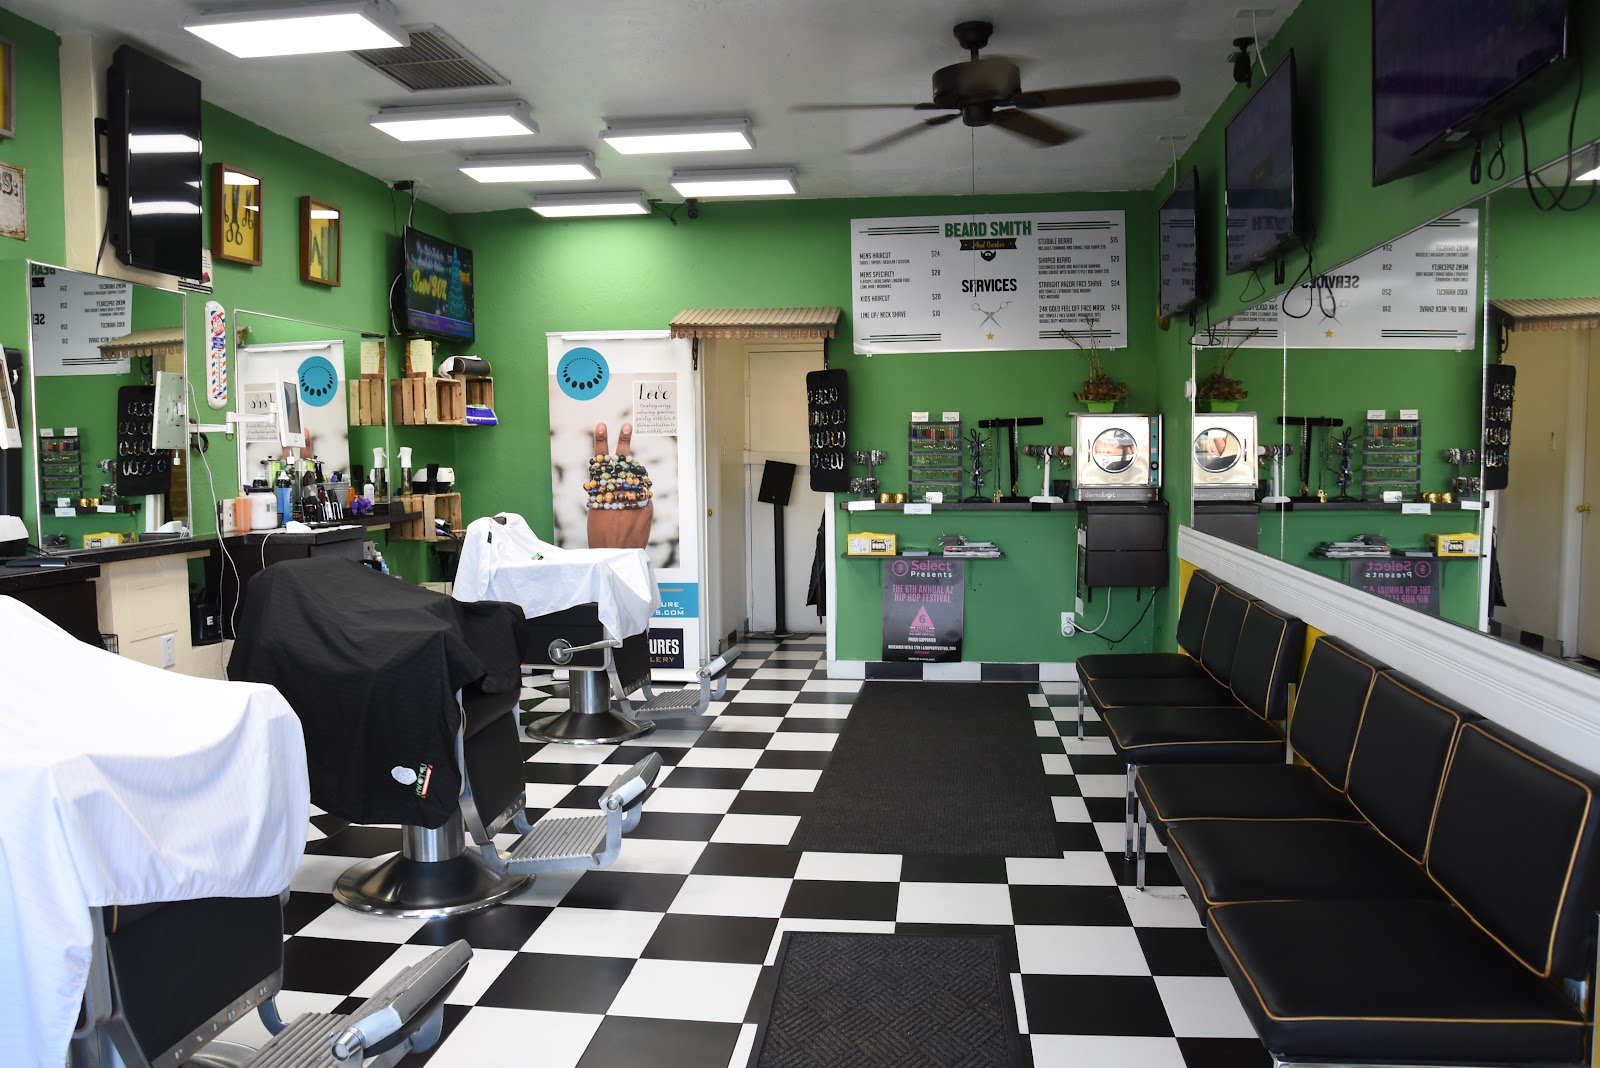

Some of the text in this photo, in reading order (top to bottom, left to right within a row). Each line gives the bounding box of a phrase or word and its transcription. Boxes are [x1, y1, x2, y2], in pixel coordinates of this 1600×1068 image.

[0, 172, 18, 197] S:
[945, 221, 1032, 238] BEARD SMITH
[1110, 236, 1118, 244] $15
[932, 293, 941, 301] $20
[639, 383, 672, 401] Love
[912, 560, 952, 571] Select
[892, 585, 954, 594] THE 6TH ANNUAL AZ
[894, 594, 951, 603] HIP HOP FESTIVAL
[649, 639, 680, 654] URES
